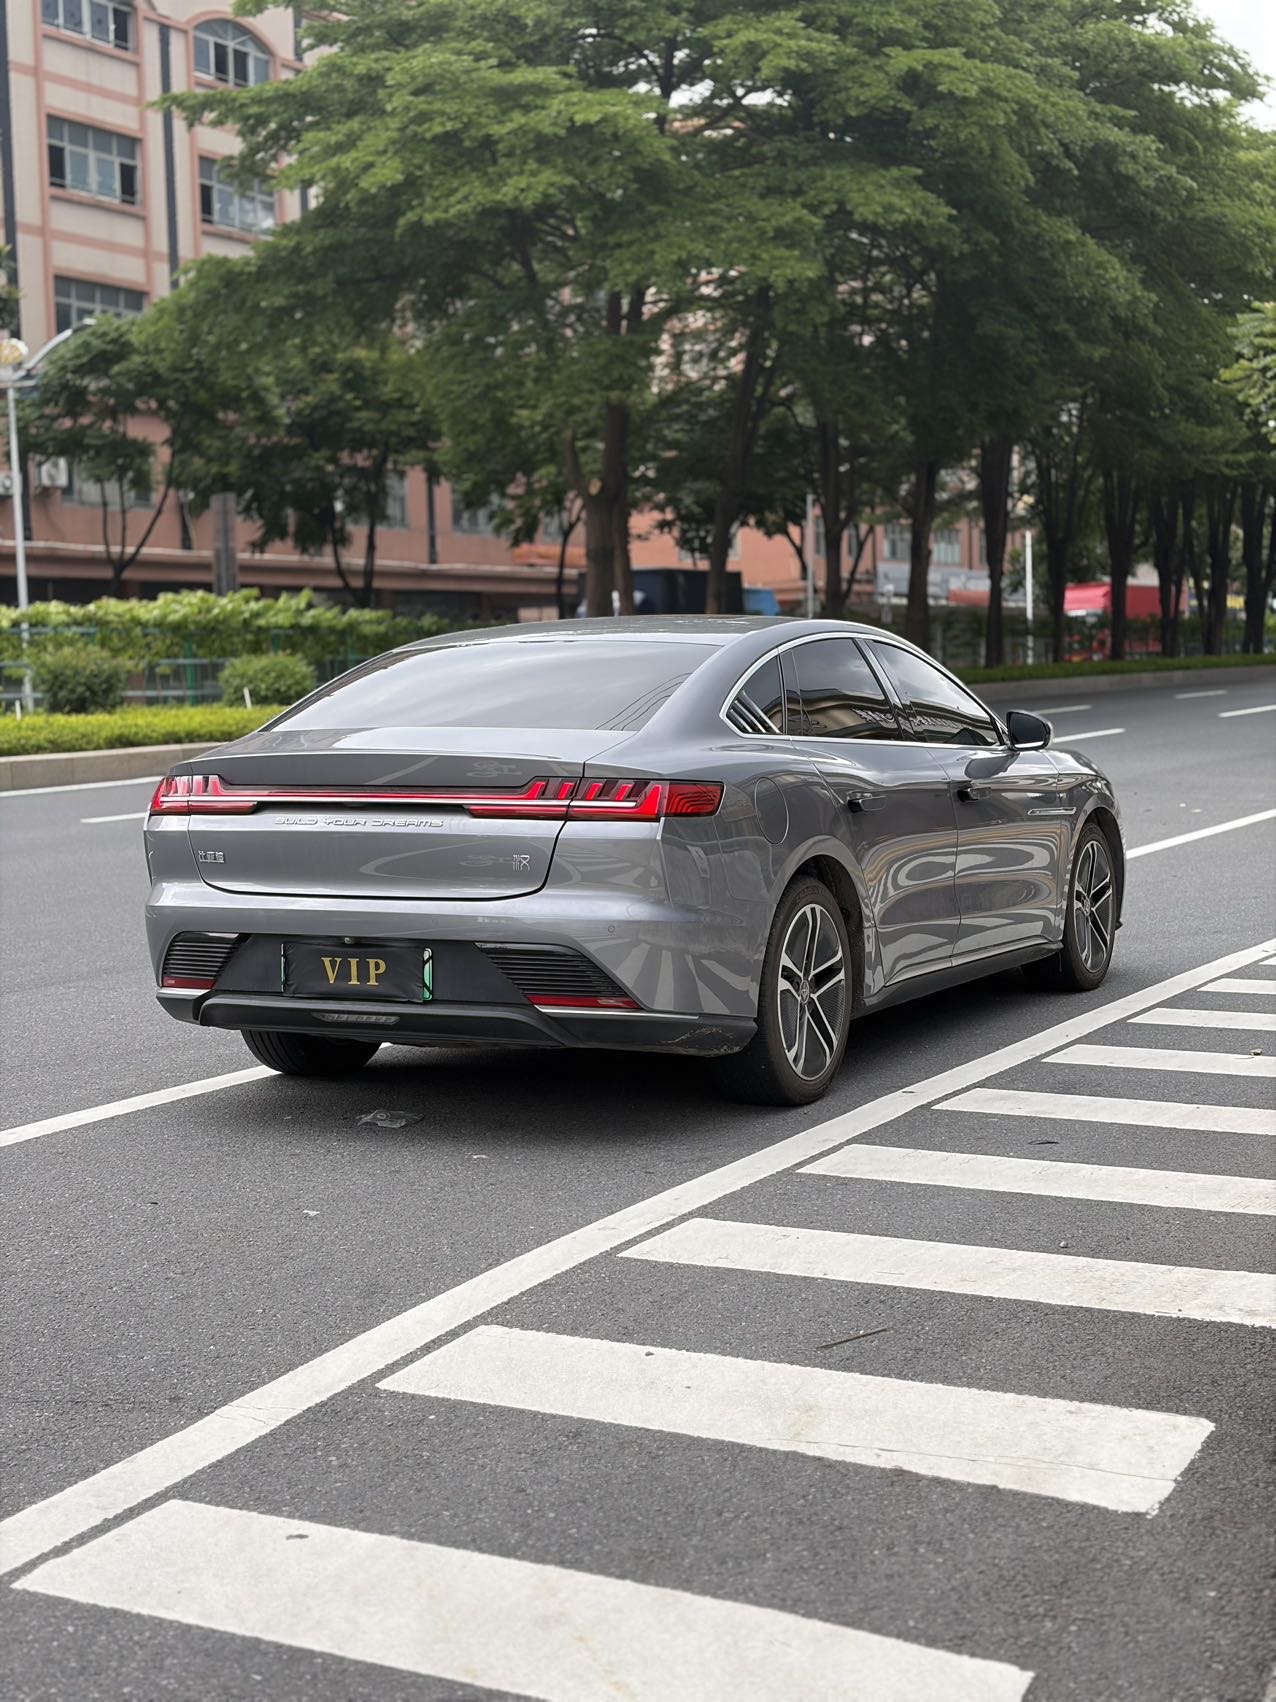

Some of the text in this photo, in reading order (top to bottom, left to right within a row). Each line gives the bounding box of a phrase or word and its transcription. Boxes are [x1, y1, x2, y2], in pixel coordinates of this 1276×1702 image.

[275, 816, 443, 828] BUILD YOUR DREAMS
[320, 957, 386, 986] VIP
